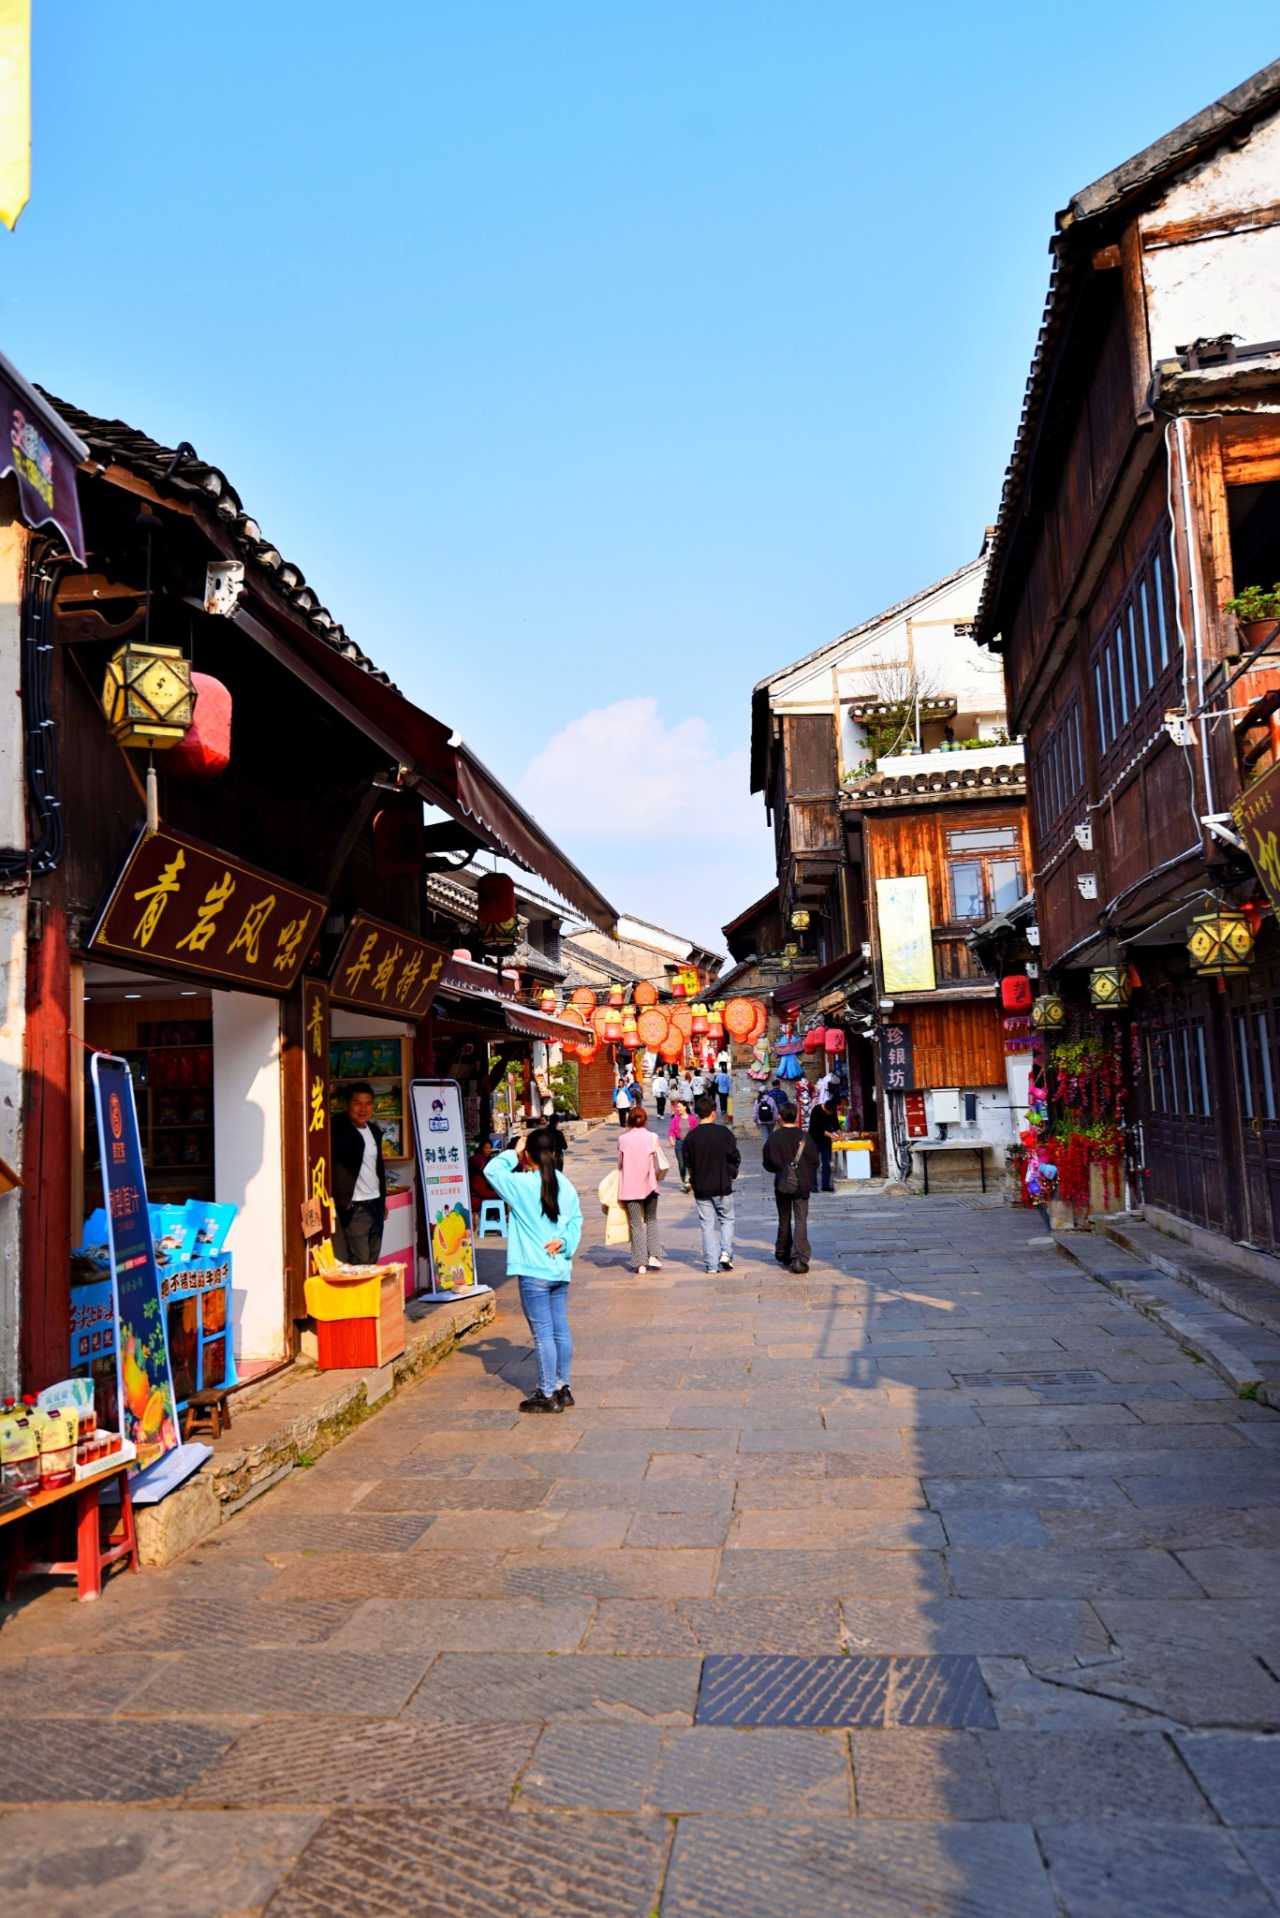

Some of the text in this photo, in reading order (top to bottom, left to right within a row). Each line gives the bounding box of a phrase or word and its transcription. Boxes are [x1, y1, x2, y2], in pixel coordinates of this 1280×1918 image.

[133, 849, 311, 971] 青岩风味
[346, 932, 443, 1009] 异域特产
[887, 1027, 905, 1087] 珍银坊
